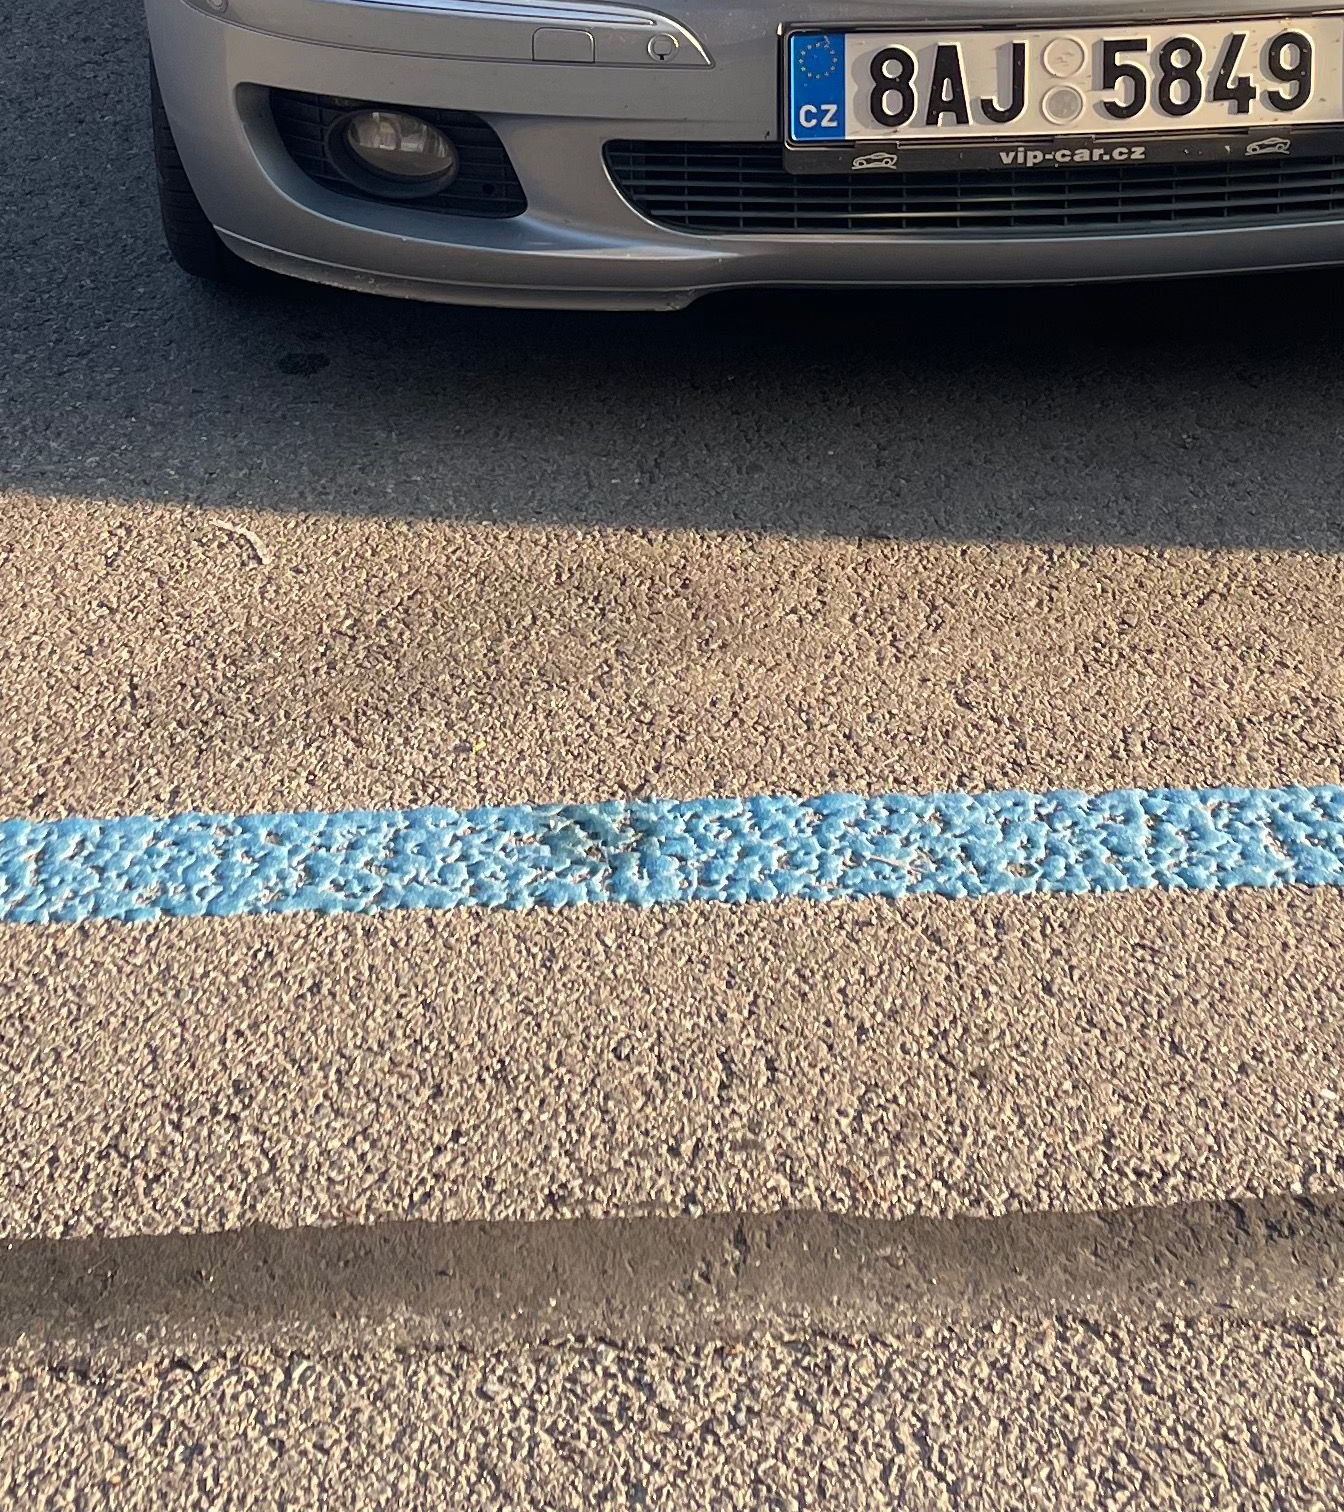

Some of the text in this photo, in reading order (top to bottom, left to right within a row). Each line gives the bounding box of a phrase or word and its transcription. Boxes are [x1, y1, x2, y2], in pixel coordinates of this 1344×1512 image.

[799, 30, 1314, 128] CZ 8AJ 5849
[999, 146, 1146, 167] vip-car.cz
